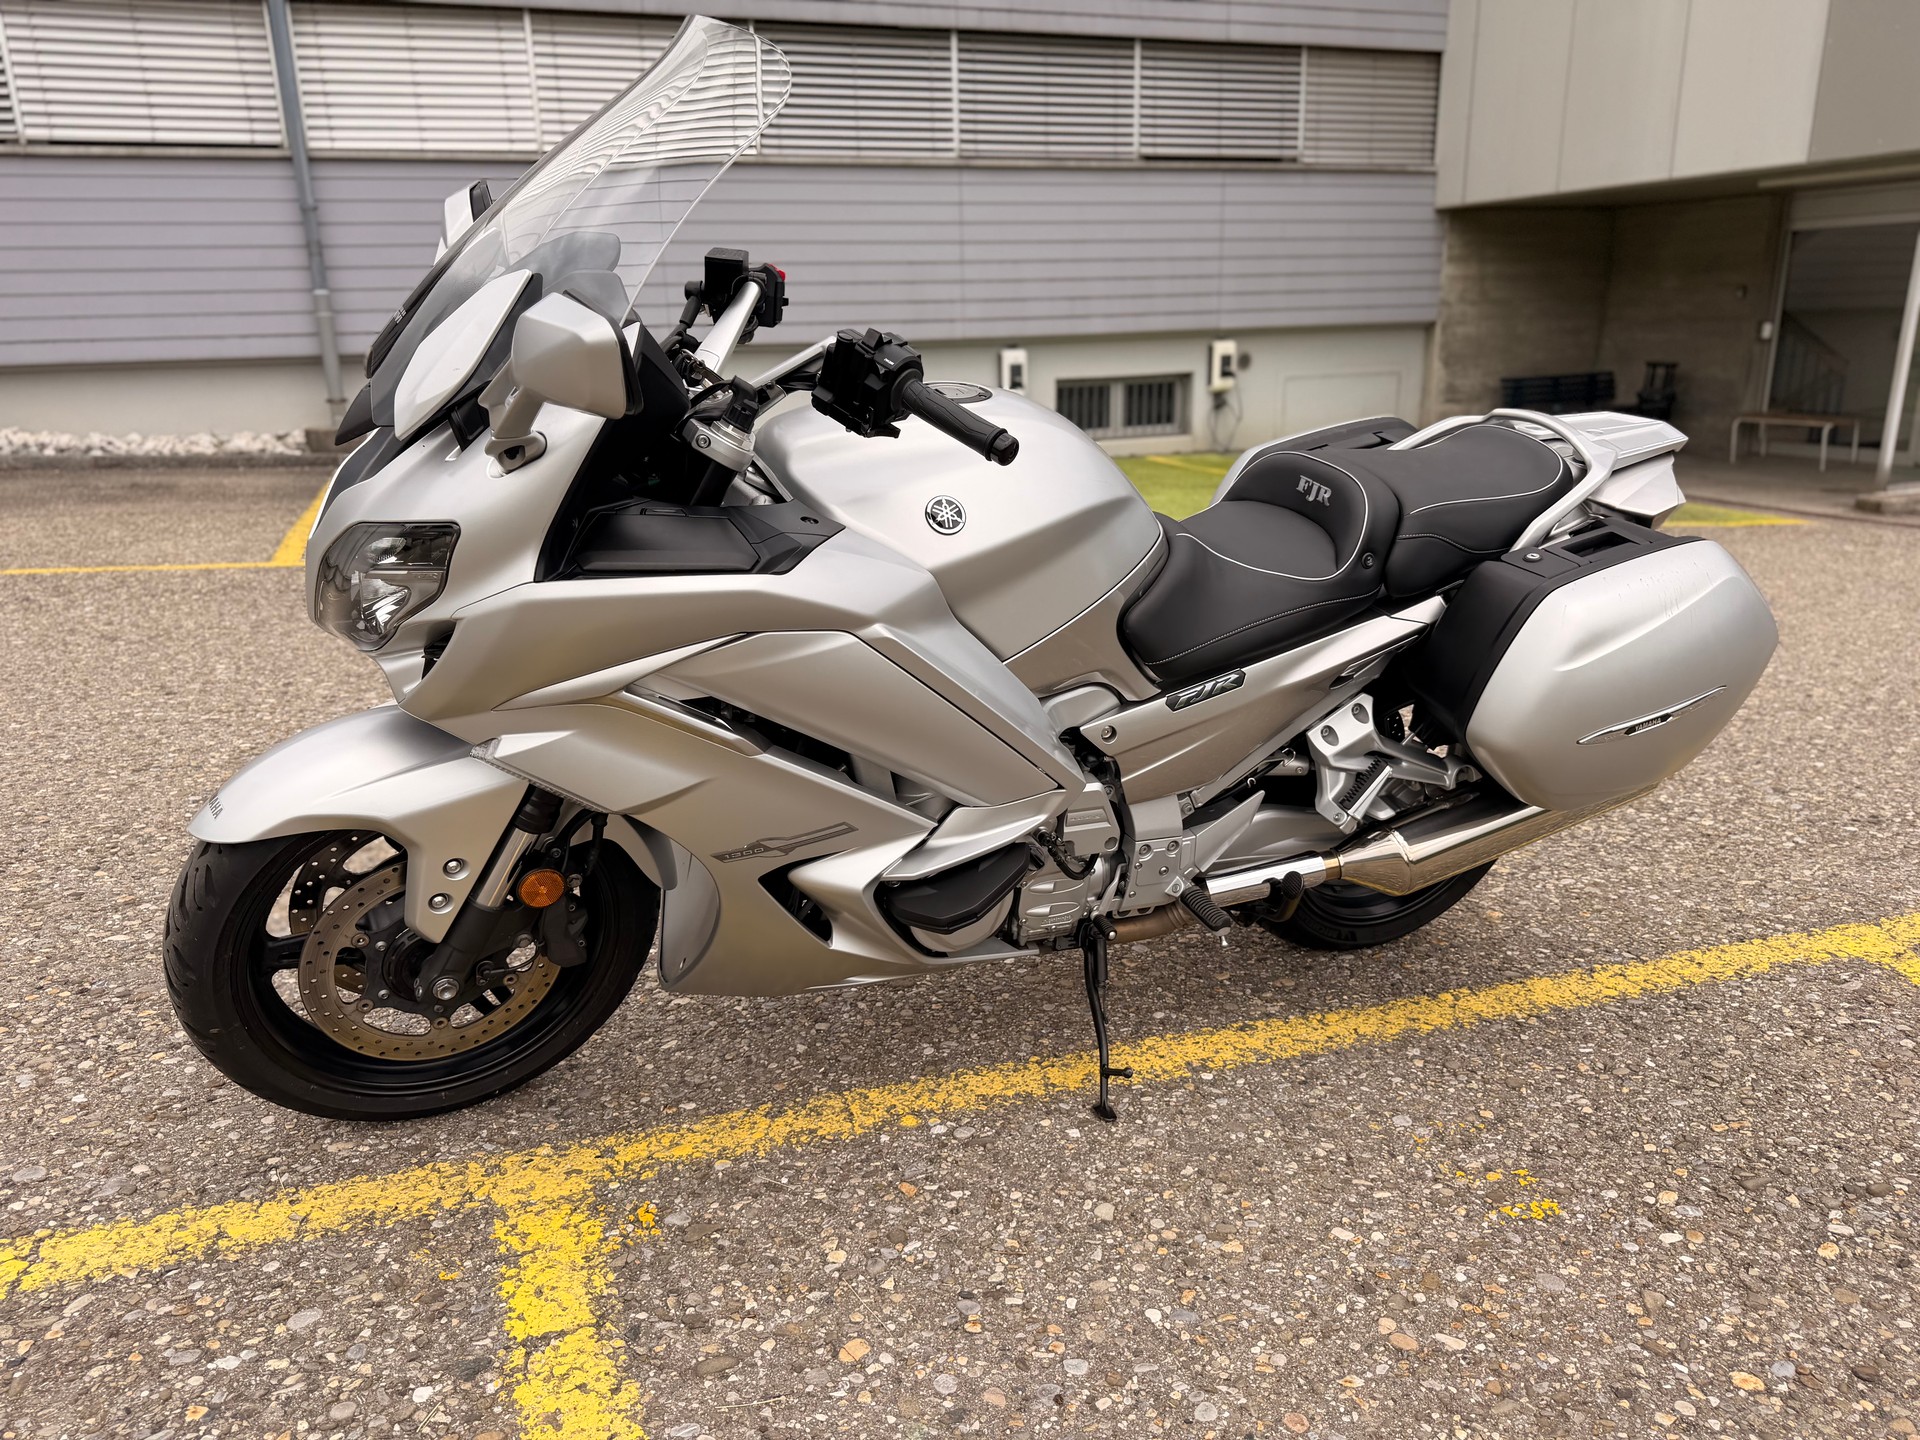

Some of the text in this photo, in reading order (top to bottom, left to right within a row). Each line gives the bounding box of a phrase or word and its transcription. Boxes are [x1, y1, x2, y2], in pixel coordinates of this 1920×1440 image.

[1295, 474, 1332, 507] FJR
[1173, 673, 1240, 709] FJR
[1635, 717, 1662, 732] YAMAHA
